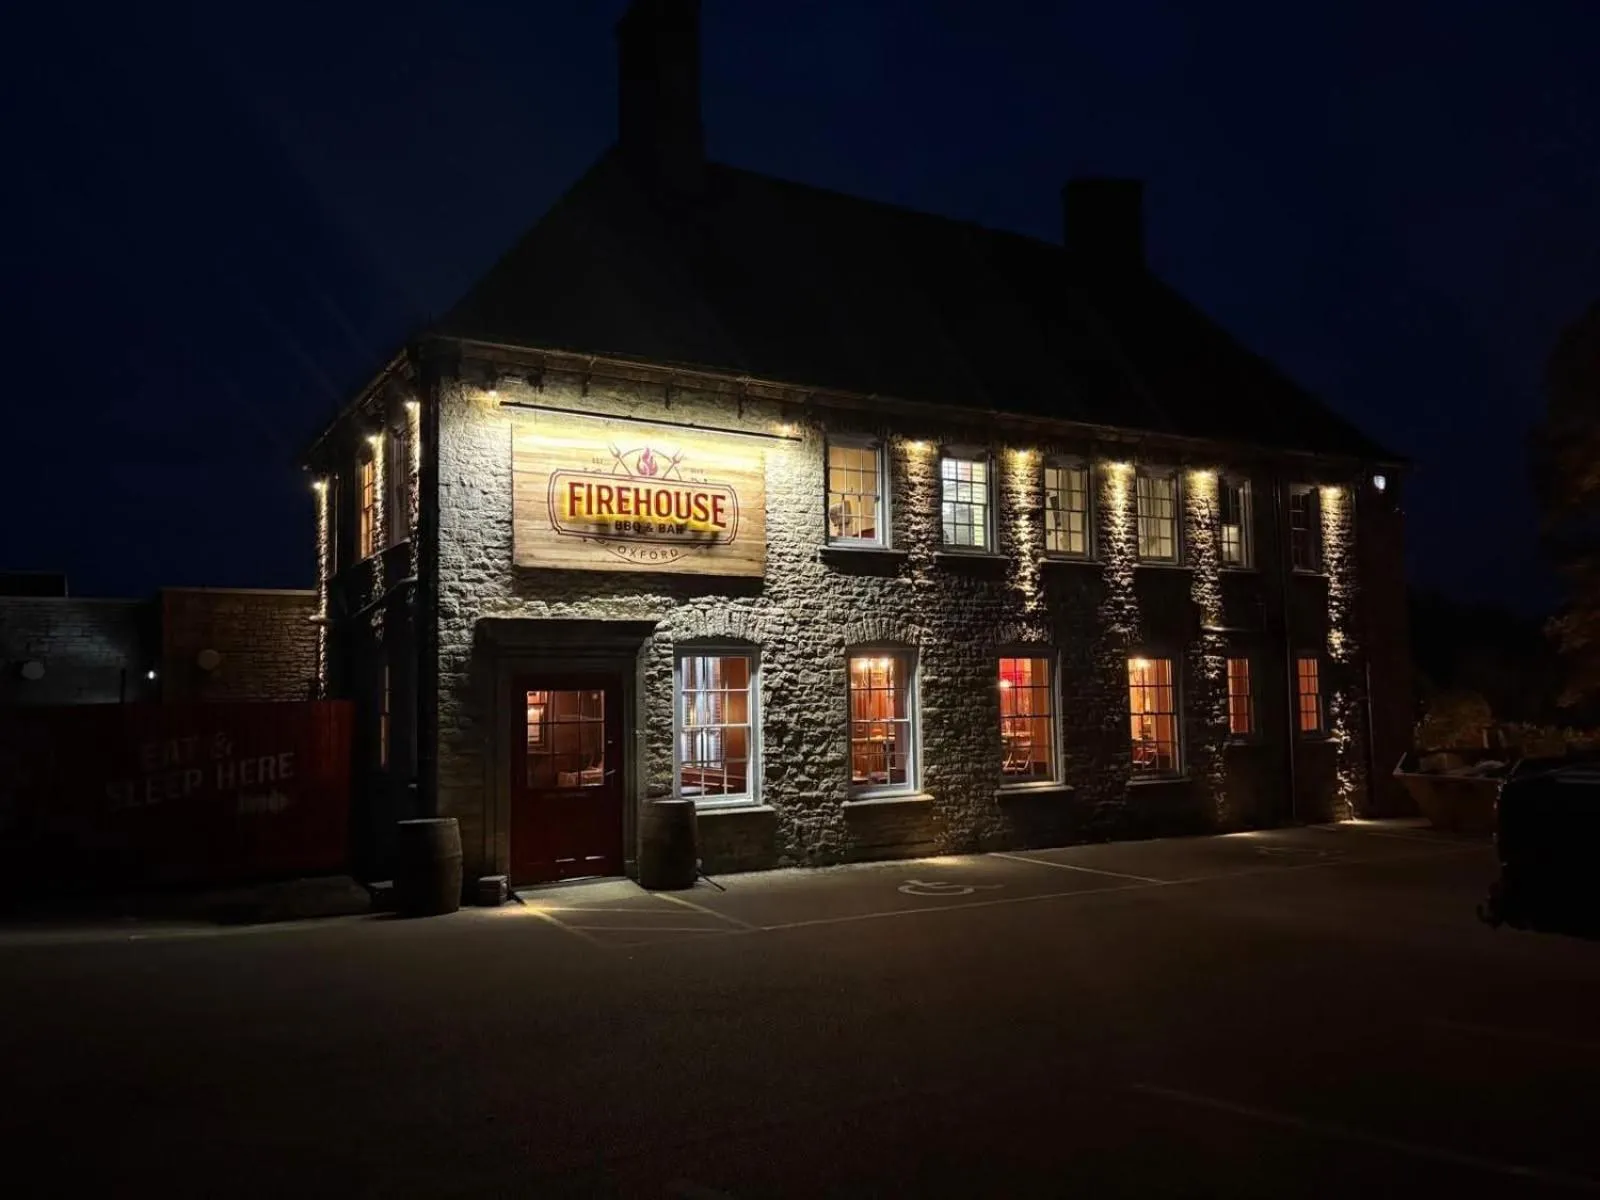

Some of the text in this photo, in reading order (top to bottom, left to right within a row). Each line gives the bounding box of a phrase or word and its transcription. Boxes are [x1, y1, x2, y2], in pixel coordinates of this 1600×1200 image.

[568, 482, 726, 528] FIREHOUSE
[615, 520, 684, 534] BBQ & BAR
[617, 545, 679, 560] OXFORD
[143, 731, 233, 767] EAT &
[105, 751, 295, 813] SLEEP HERE
